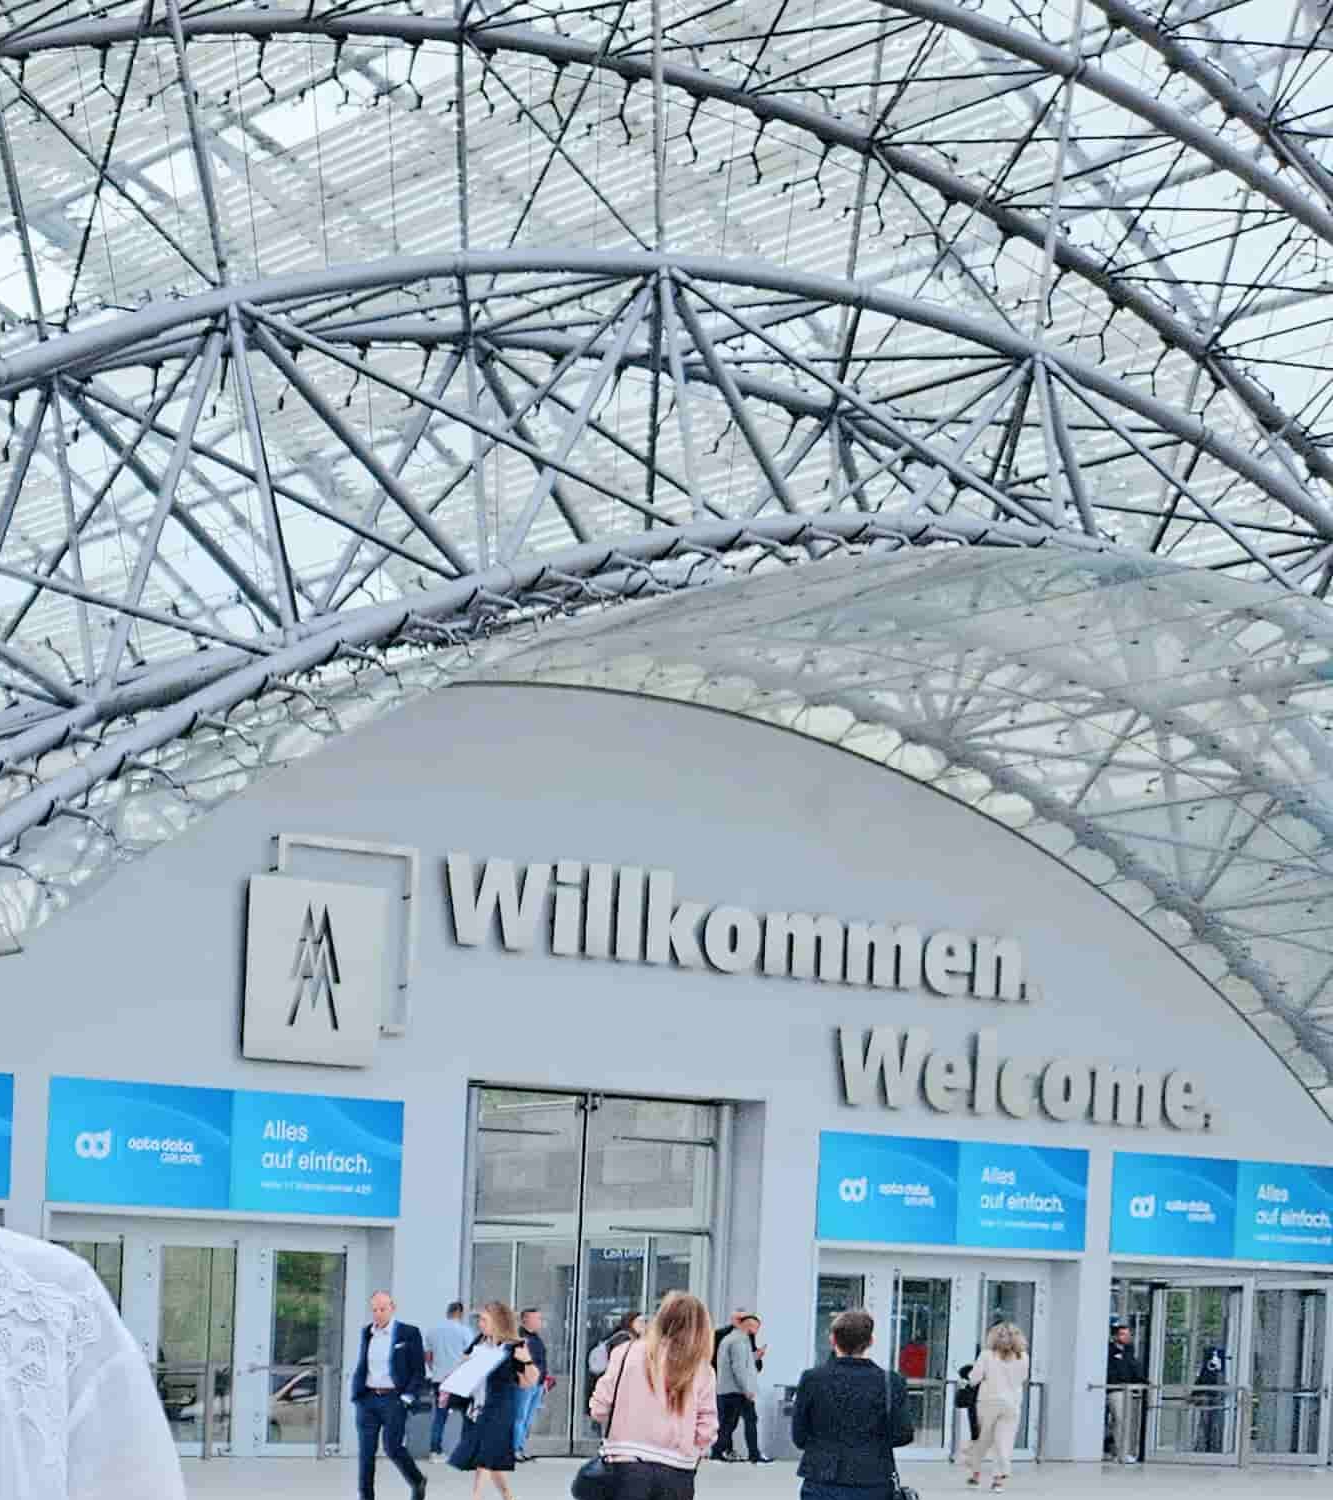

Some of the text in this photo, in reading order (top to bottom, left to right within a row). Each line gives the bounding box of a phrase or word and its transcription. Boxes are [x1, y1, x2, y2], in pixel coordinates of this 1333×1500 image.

[443, 849, 1031, 1003] Willkommen.
[833, 1023, 1215, 1132] Welcome.
[260, 1147, 373, 1175] auf einfach.
[261, 1118, 310, 1143] Alles
